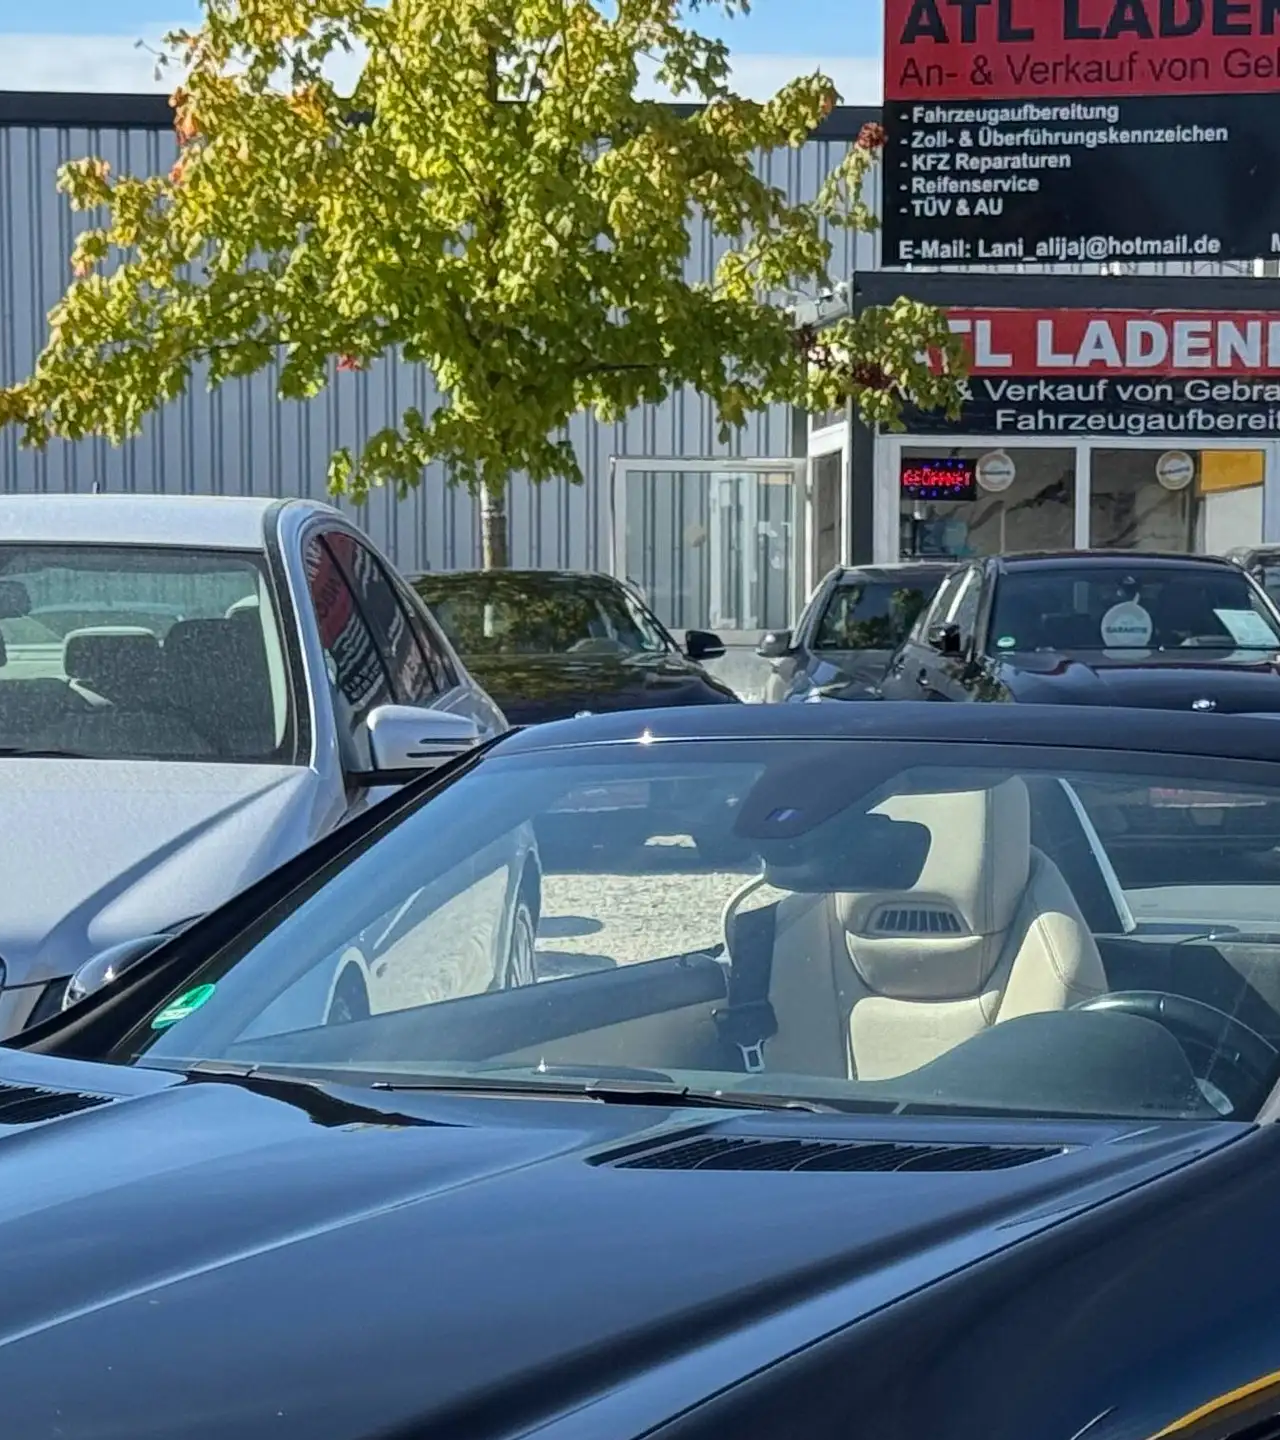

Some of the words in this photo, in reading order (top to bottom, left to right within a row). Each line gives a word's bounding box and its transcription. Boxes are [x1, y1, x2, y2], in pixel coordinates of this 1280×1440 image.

[900, 0, 1034, 44] ATL
[899, 57, 958, 87] An-
[970, 54, 994, 86] &
[1006, 52, 1136, 85] Verkauf
[1147, 57, 1209, 82] von
[912, 104, 1119, 127] Fahrzeugaufbereitung
[911, 131, 954, 149] Zoll-
[959, 131, 973, 148] &
[978, 124, 1229, 149] Überführungskennzeichen
[912, 153, 950, 172] KFZ
[956, 153, 1071, 174] Reparaturen
[912, 175, 1039, 194] Reifenservice
[911, 195, 951, 217] TÜV
[956, 199, 970, 216] &
[974, 198, 1003, 216] AU
[899, 239, 972, 260] E-Mail:
[978, 234, 1221, 262] Lani_alijaj@hotmail.de
[983, 379, 1109, 402] Verkauf
[1116, 382, 1173, 401] von
